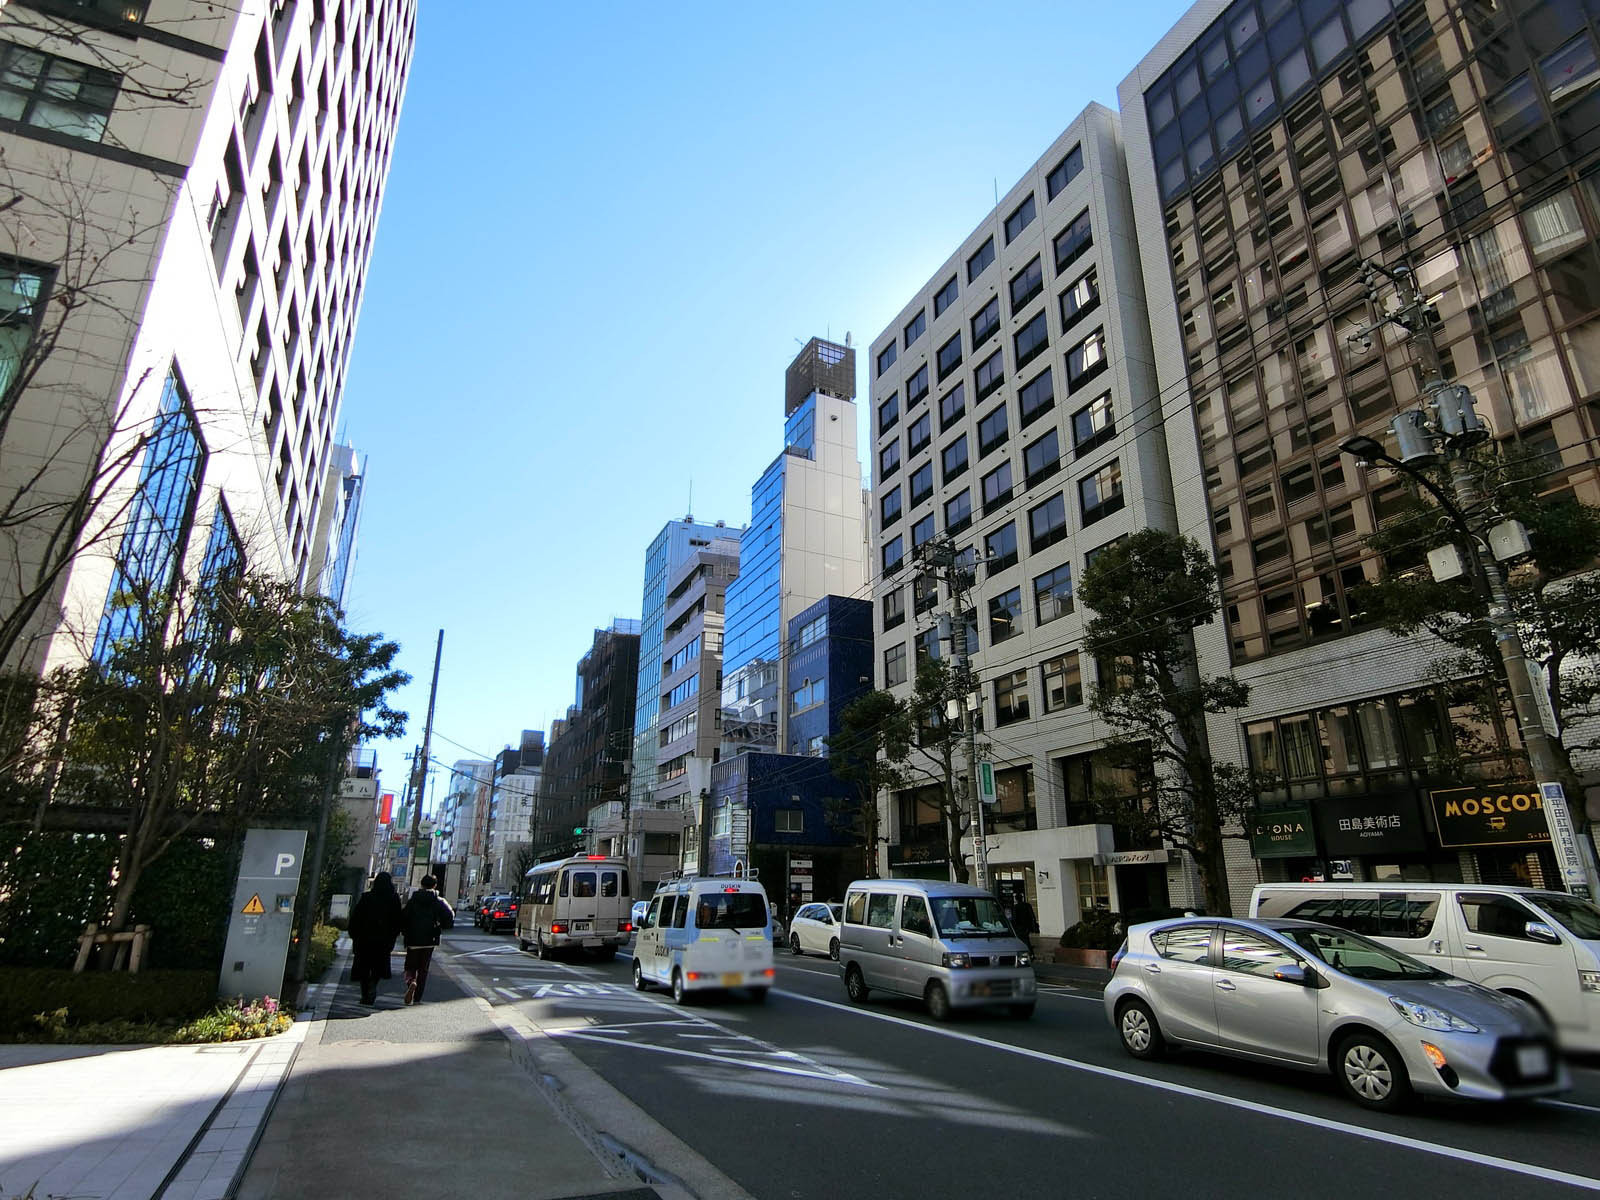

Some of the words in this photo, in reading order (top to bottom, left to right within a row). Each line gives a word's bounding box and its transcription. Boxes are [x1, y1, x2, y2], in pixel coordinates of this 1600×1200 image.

[1445, 793, 1543, 817] MOSCOT
[1338, 814, 1401, 831] 田島美術店
[274, 853, 295, 876] P
